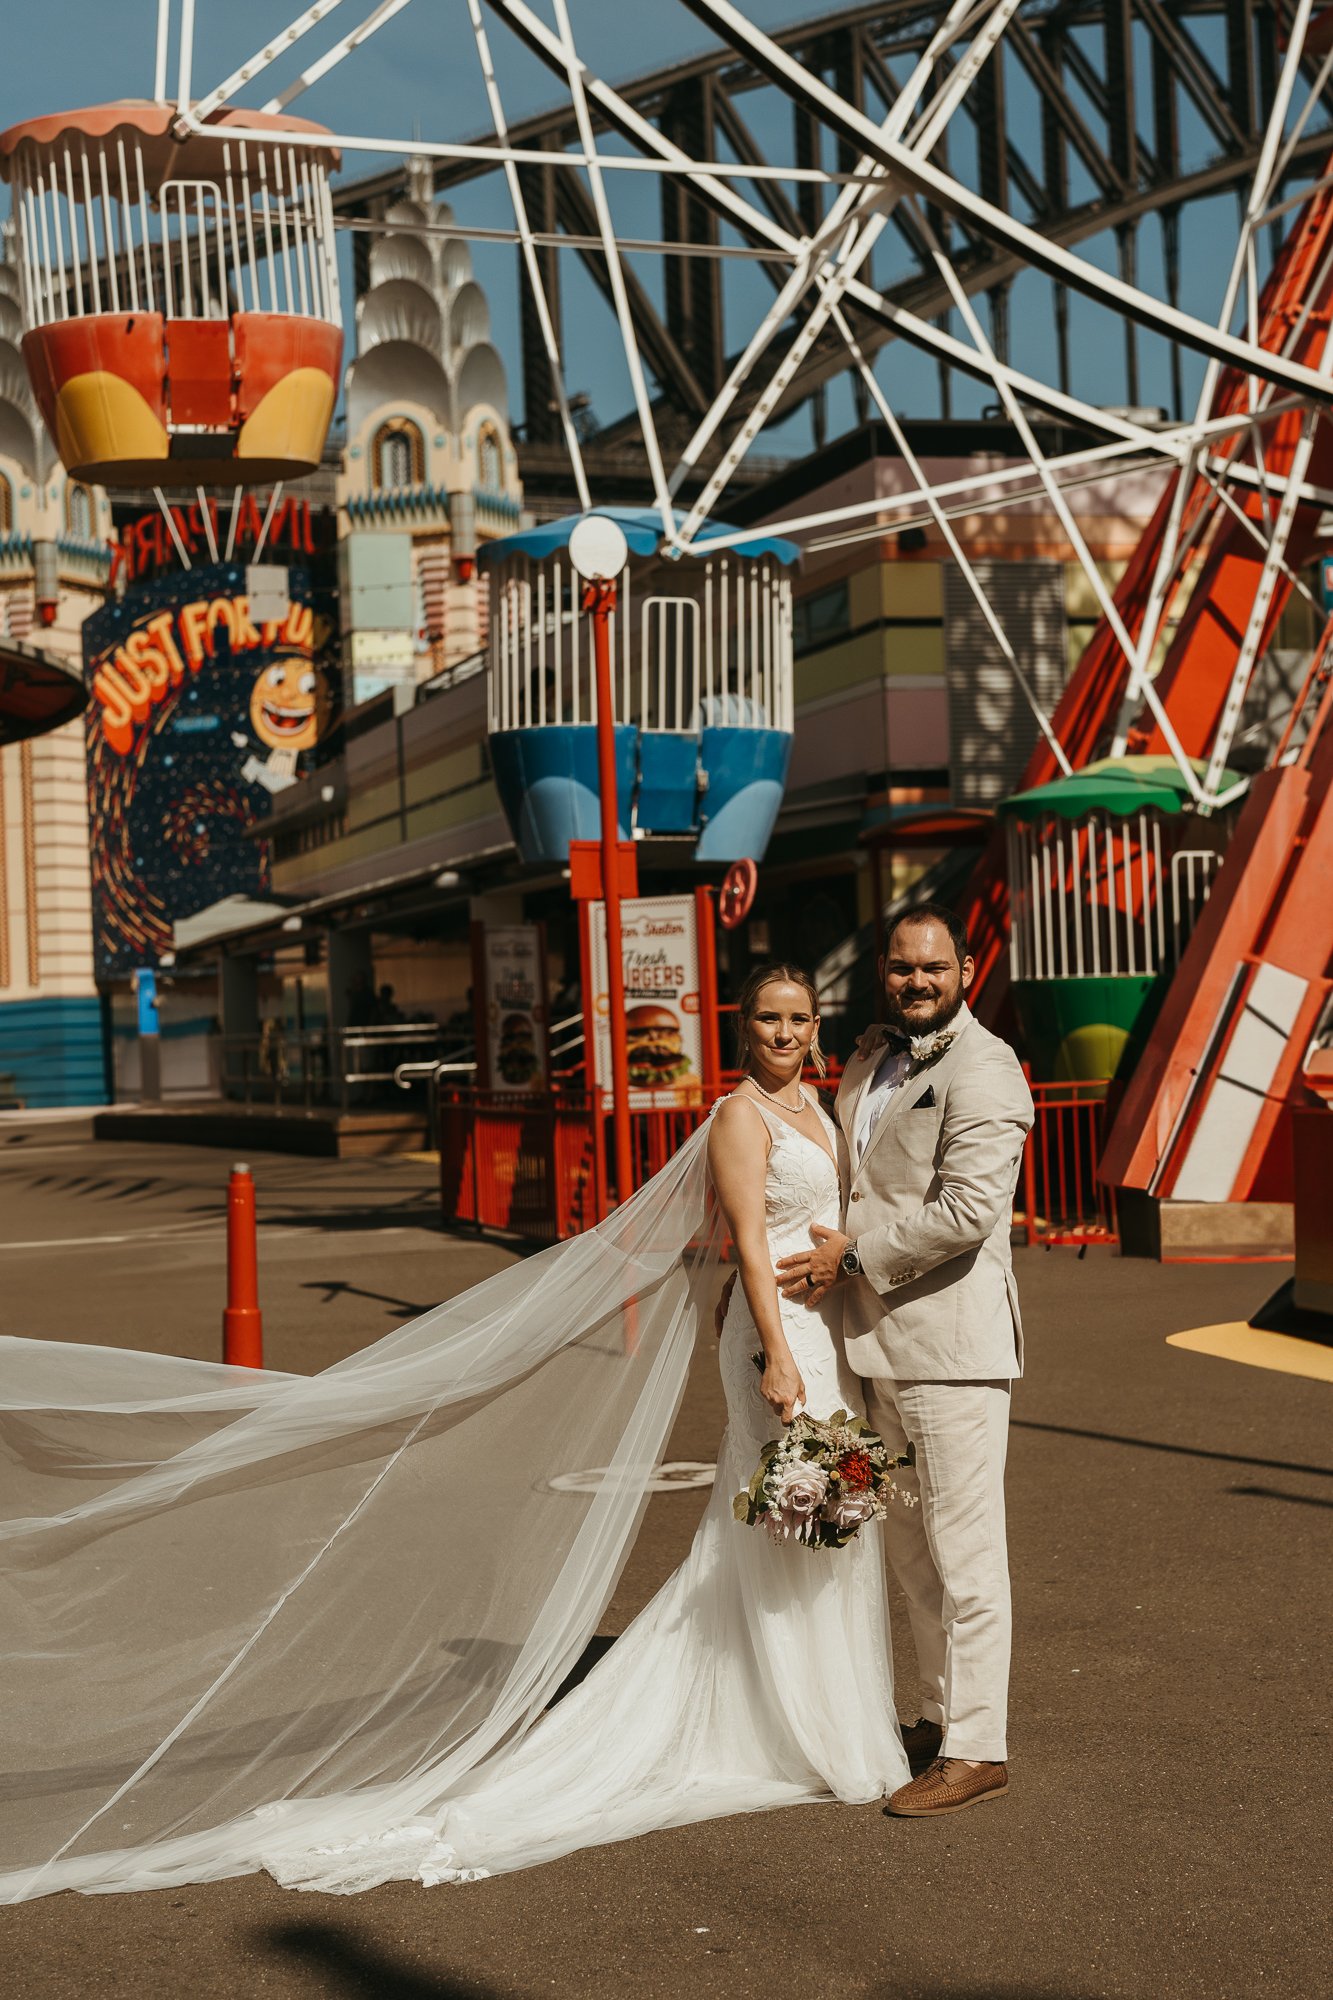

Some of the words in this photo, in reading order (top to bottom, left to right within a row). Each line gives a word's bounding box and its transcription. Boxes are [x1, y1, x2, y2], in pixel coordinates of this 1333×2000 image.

[92, 610, 185, 738] JUST
[178, 596, 262, 670] FOR
[622, 946, 667, 970] Fresh
[623, 964, 685, 988] URGERS
